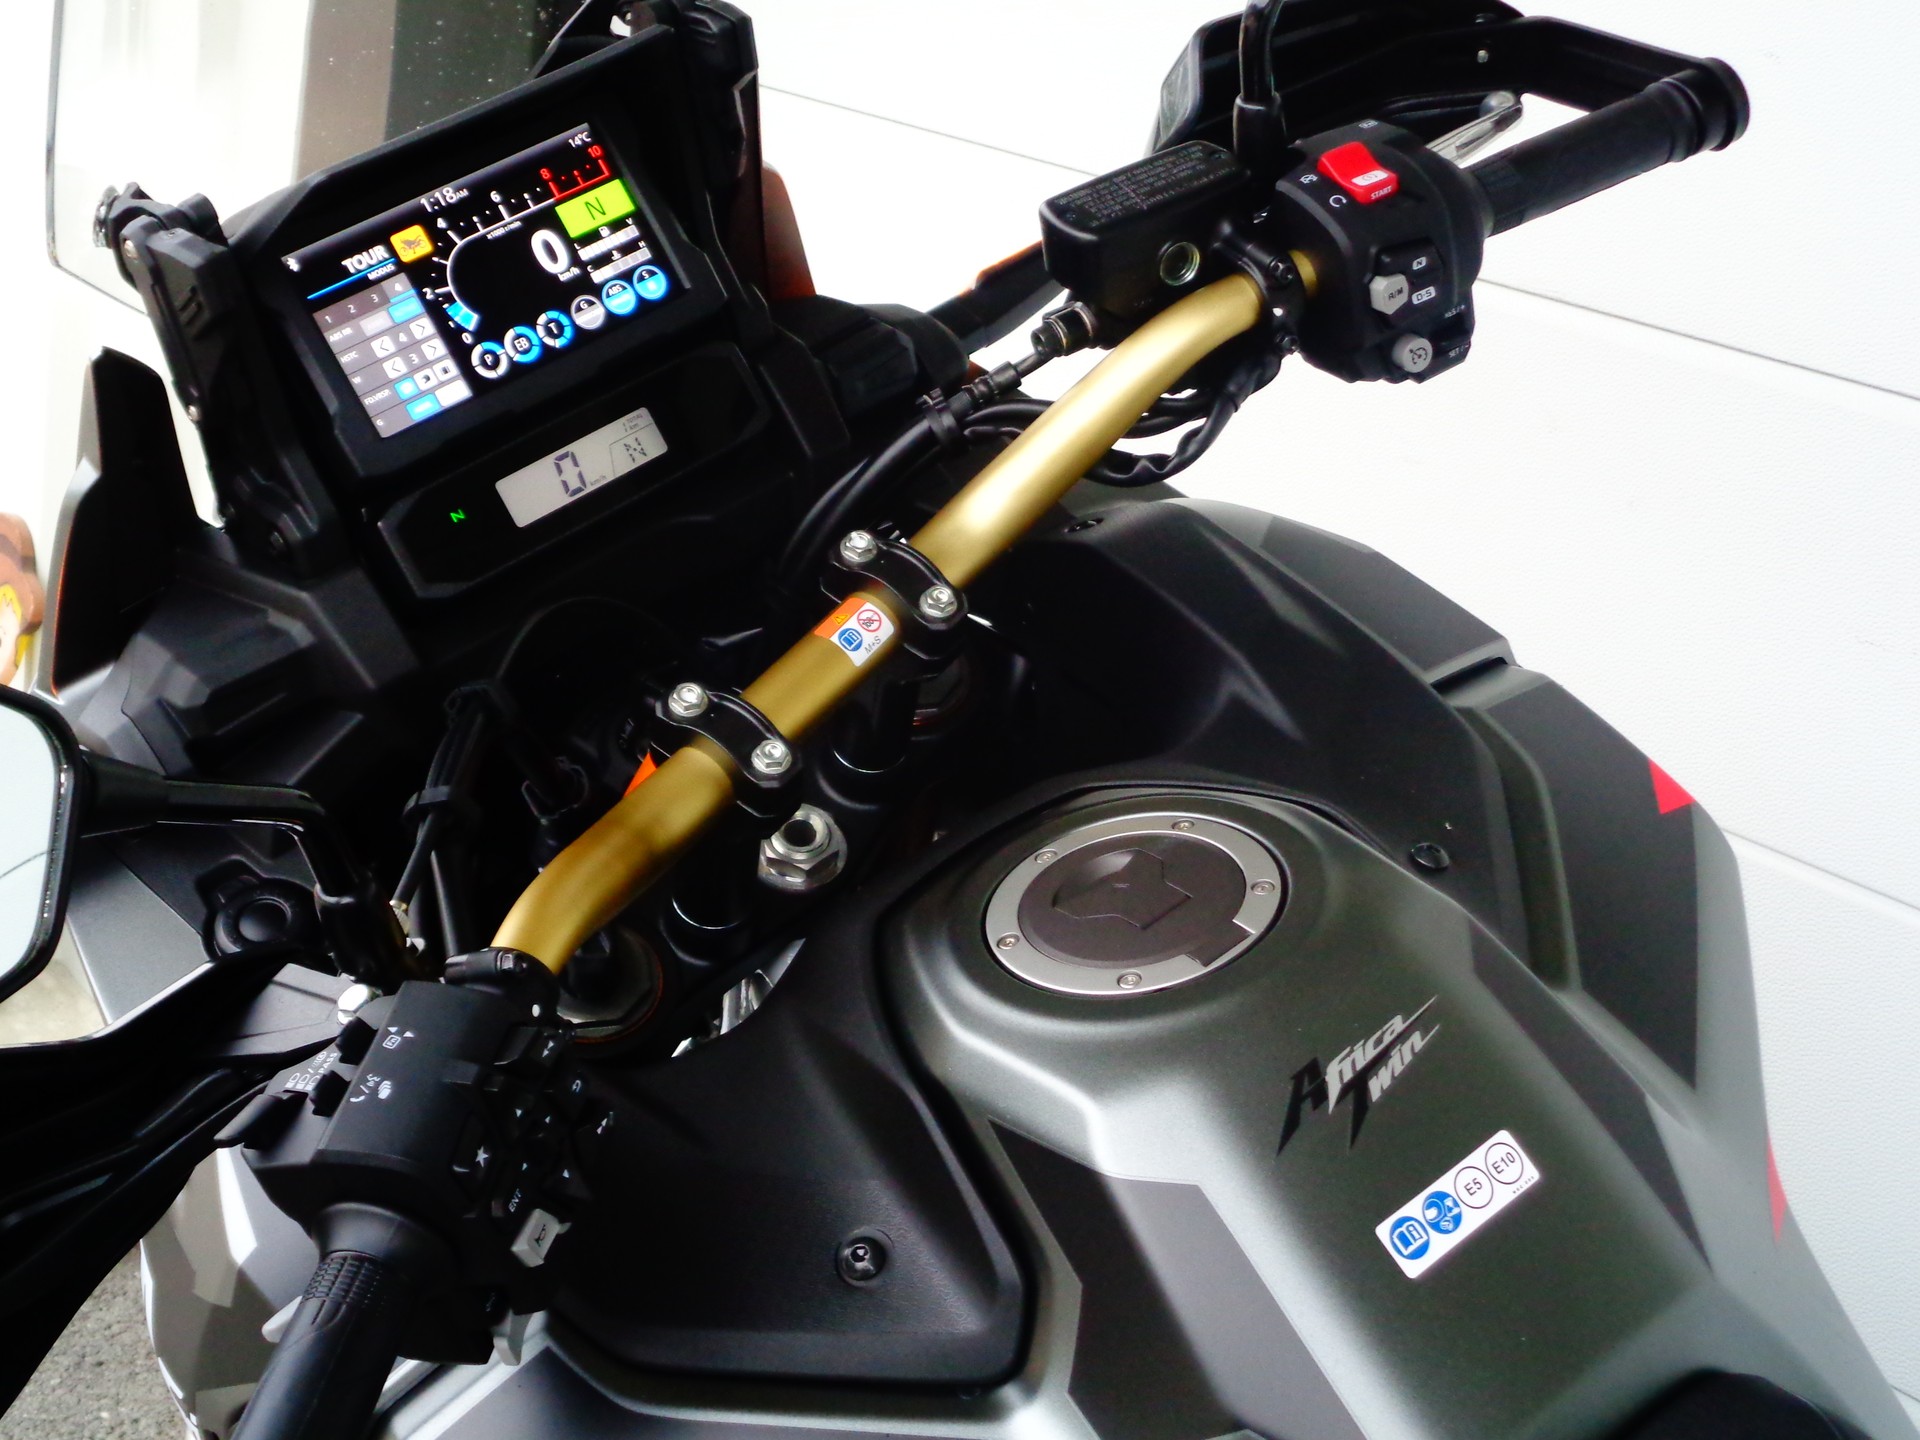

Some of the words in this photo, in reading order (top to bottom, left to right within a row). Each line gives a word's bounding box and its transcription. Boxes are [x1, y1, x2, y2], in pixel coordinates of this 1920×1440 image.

[568, 131, 591, 148] 14°C
[588, 145, 603, 158] 10
[539, 168, 552, 180] 8
[420, 187, 457, 212] 1:18
[455, 188, 469, 200] AM
[490, 190, 501, 203] 6
[1370, 185, 1392, 200] START
[584, 197, 607, 221] N
[436, 217, 447, 229] 4
[341, 244, 389, 274] TOUR
[531, 229, 570, 275] 0
[367, 264, 395, 280] MODUS
[557, 266, 581, 282] km/h
[422, 288, 434, 300] 2
[607, 284, 623, 296] ABS
[324, 315, 332, 323] 1
[347, 304, 356, 313] 2
[371, 294, 379, 303] 3
[394, 282, 402, 292] 4
[579, 300, 588, 310] G
[548, 322, 558, 334] T
[398, 332, 407, 342] 4
[461, 332, 473, 344] 0
[514, 337, 529, 351] EB
[409, 353, 419, 364] 3
[484, 354, 493, 366] P
[376, 419, 384, 427] G
[553, 450, 587, 498] 0
[450, 508, 466, 523] N
[864, 635, 881, 654] M+S
[318, 1052, 338, 1073] PASS
[1276, 994, 1440, 1158] Africa
[1335, 1023, 1441, 1151] Twin
[1491, 1151, 1516, 1174] E10
[1464, 1177, 1483, 1196] E5
[508, 1188, 522, 1213] ENT
